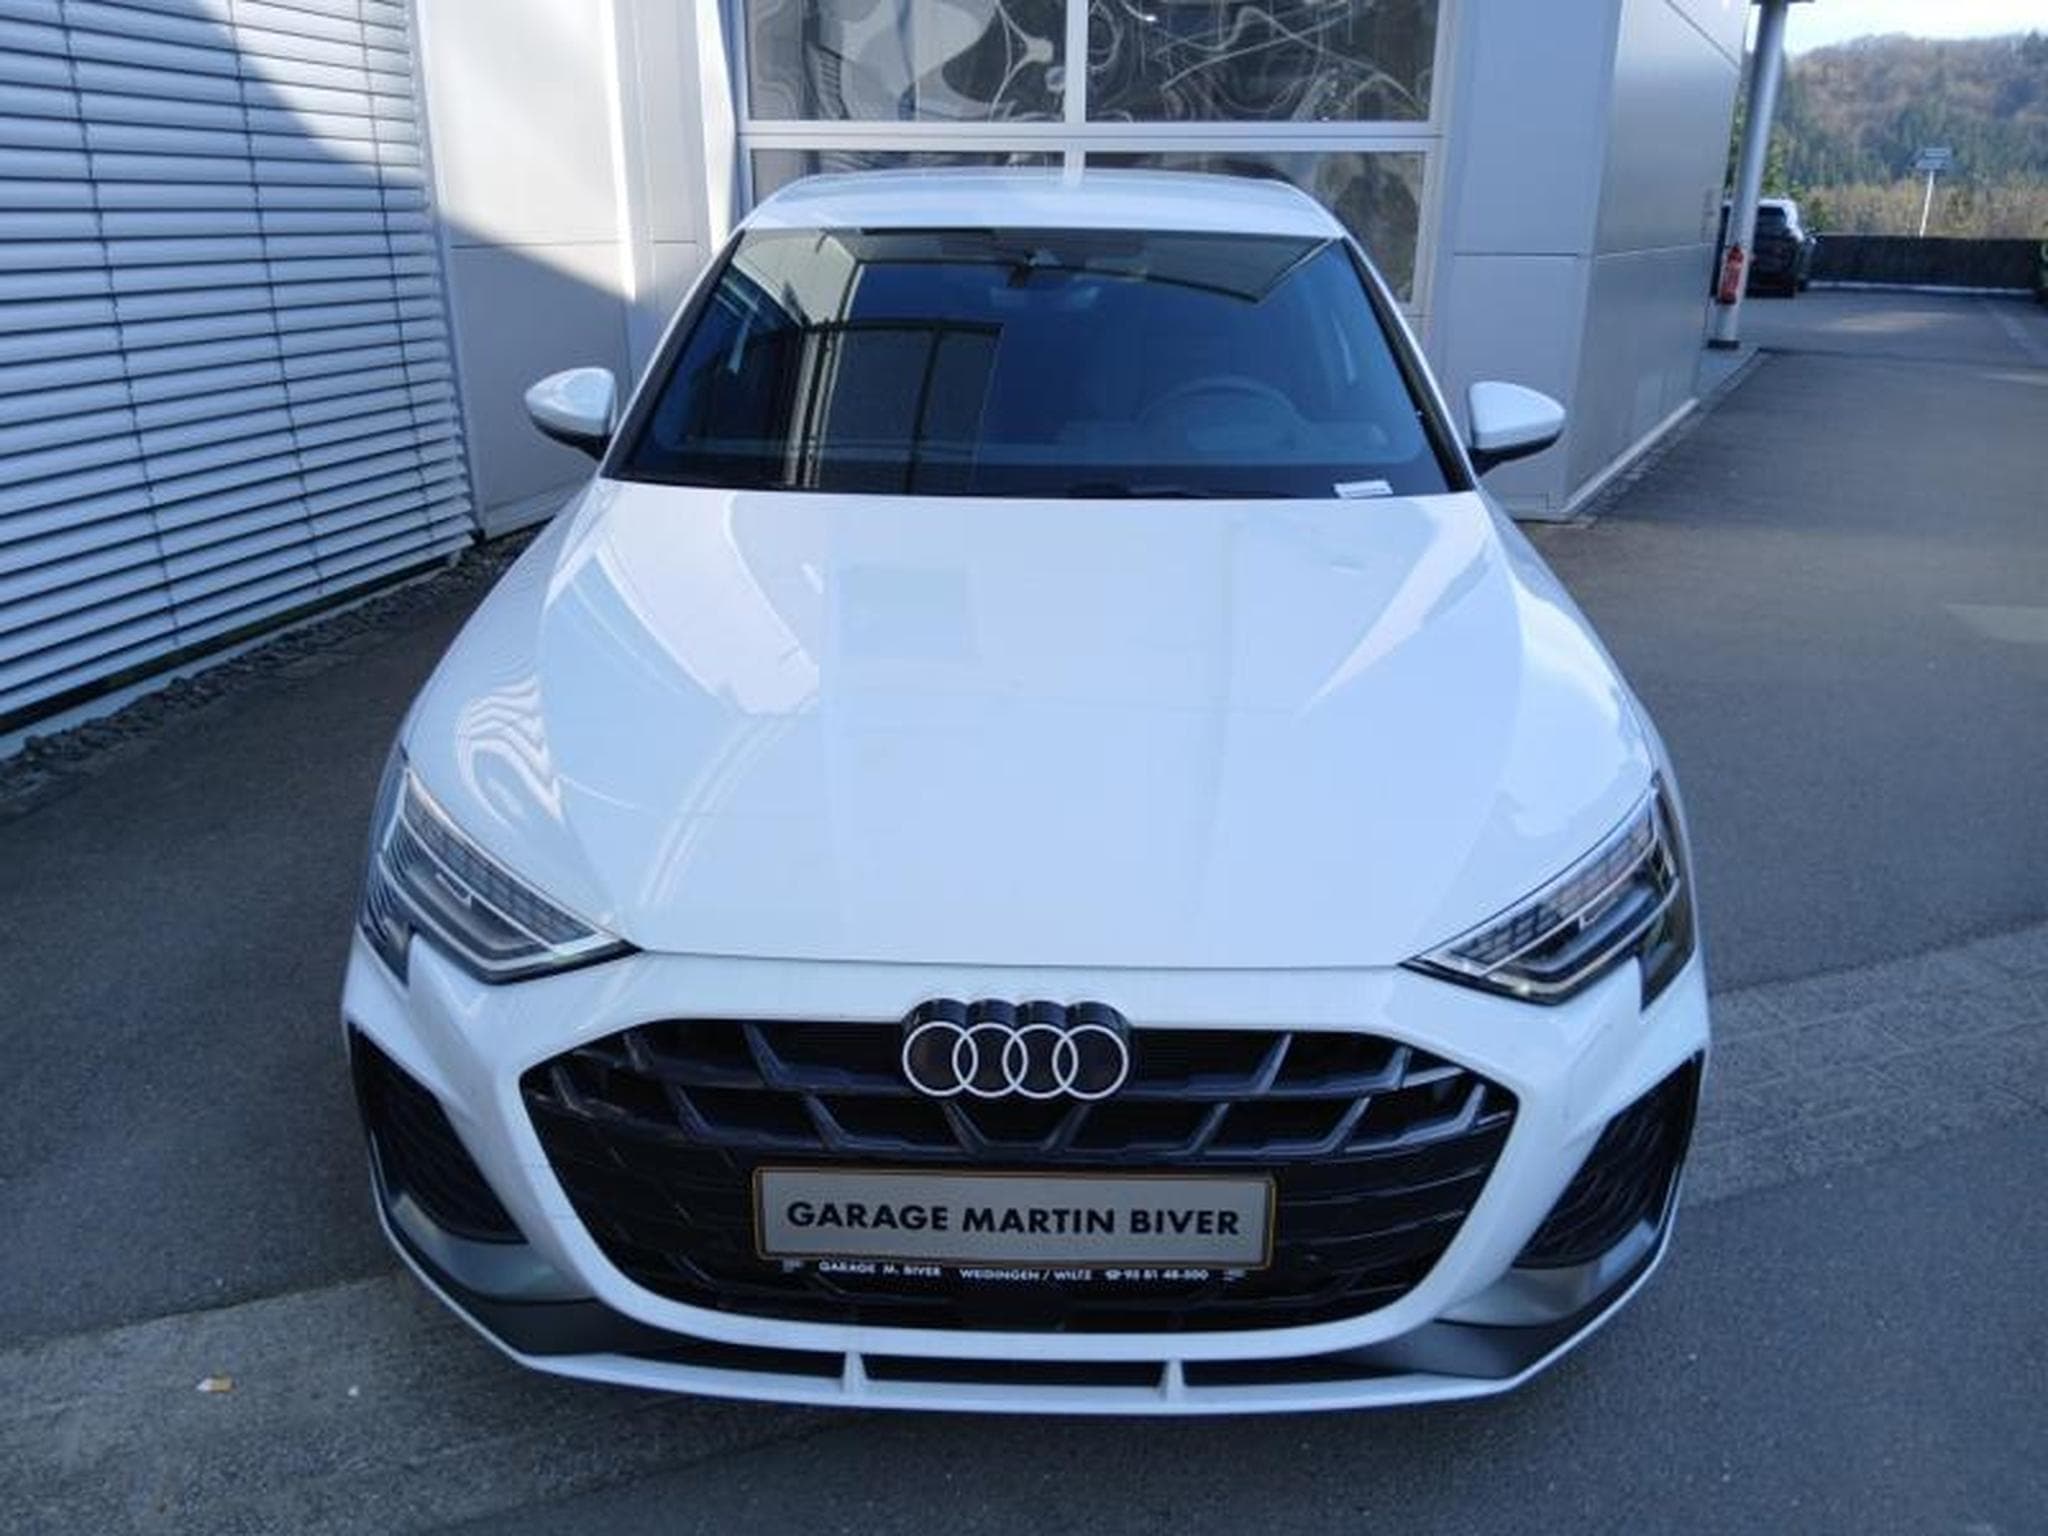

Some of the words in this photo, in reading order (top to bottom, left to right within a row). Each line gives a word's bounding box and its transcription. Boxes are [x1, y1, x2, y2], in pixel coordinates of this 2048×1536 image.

[786, 1201, 949, 1232] GARAGE
[962, 1206, 1115, 1235] MARTIN
[1129, 1208, 1240, 1236] BIVER
